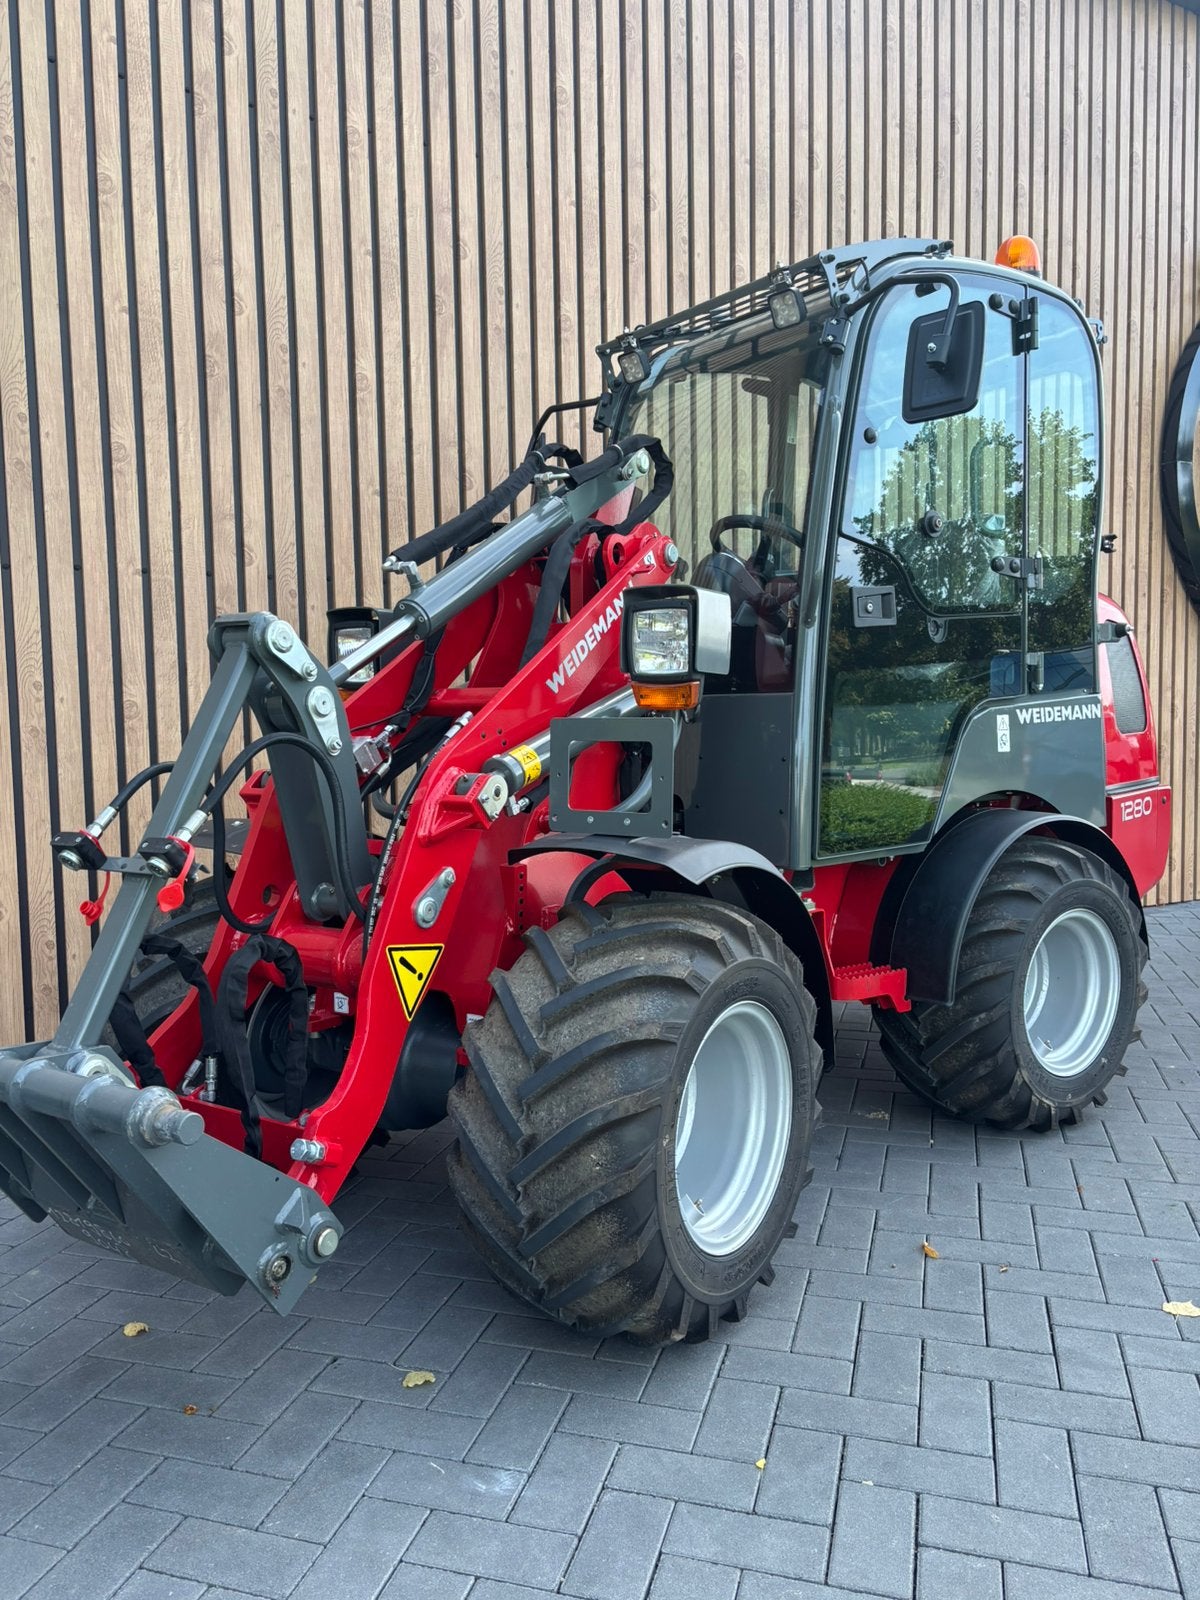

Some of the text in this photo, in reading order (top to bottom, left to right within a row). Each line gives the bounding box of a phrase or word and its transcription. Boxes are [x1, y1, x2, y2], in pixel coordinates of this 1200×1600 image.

[545, 579, 634, 694] WEIDEMAN
[1015, 703, 1102, 725] WEIDEMANN
[1120, 796, 1153, 822] 1280
